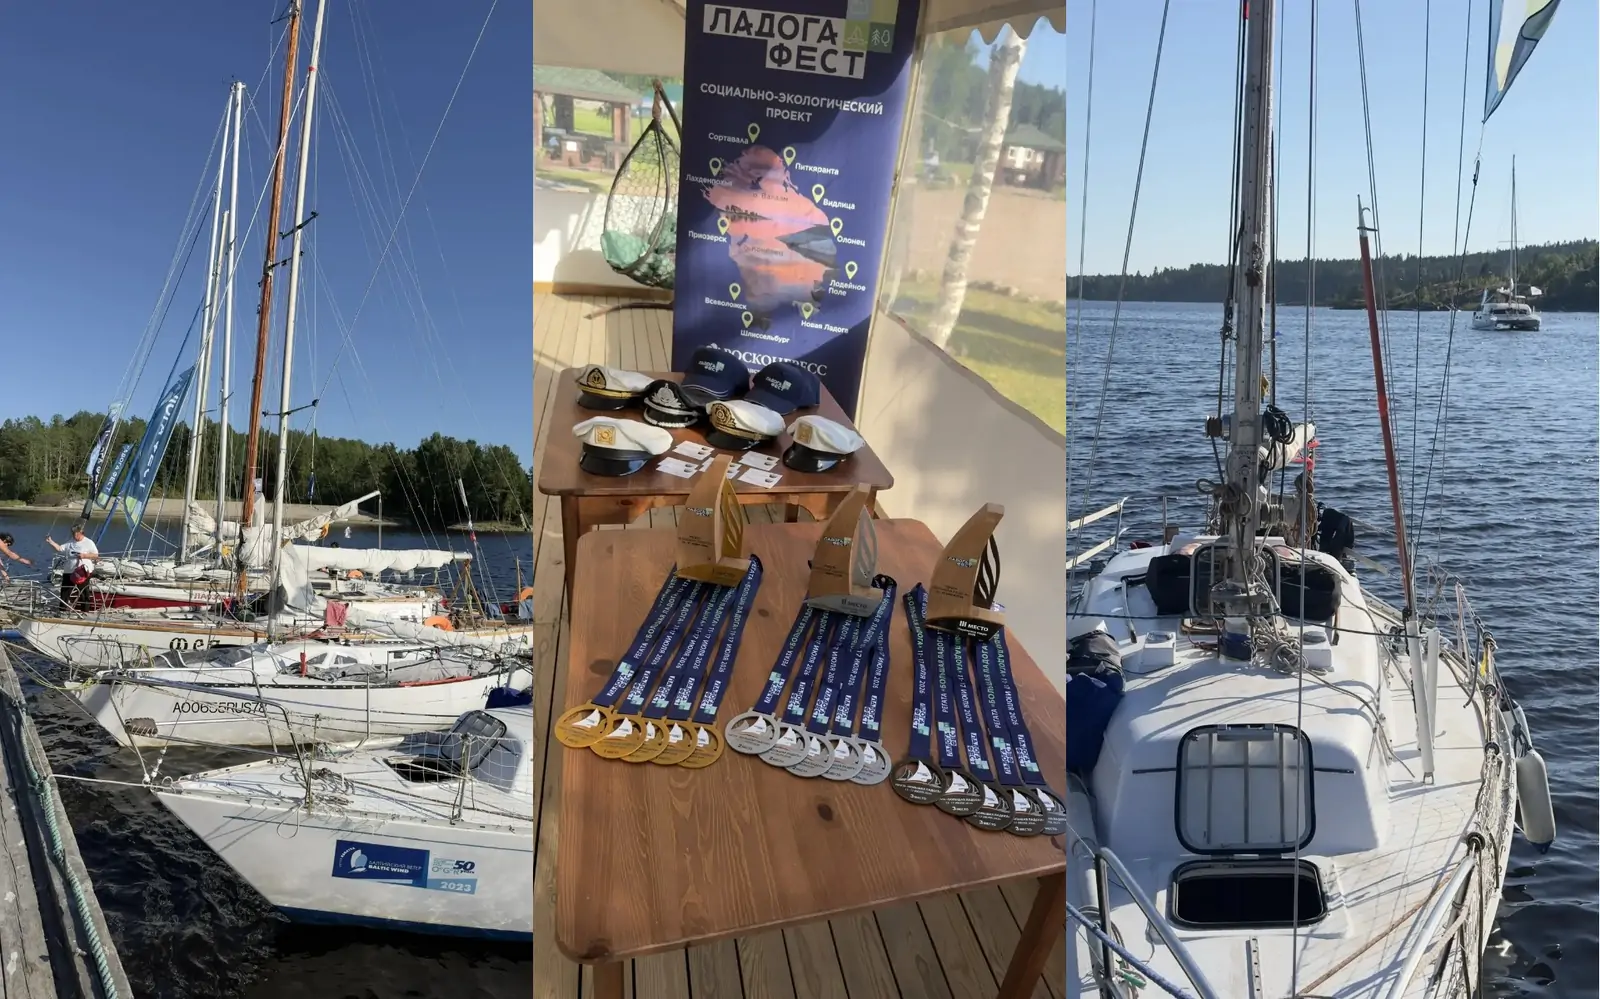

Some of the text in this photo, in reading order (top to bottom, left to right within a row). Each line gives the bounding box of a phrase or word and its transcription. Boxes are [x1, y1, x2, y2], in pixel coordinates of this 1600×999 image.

[709, 7, 839, 46] ЛАДОГА
[769, 42, 864, 76] ФЕСТ
[700, 82, 884, 116] СОЦИАЛЬНО-ЭКОЛОГИЧЕСКИЙ
[766, 107, 812, 123] ПРОЕКТ
[708, 132, 749, 145] Сортавала
[795, 162, 839, 176] Питкяранта
[823, 198, 856, 211] Видлица
[688, 230, 728, 244] Приозерск
[836, 235, 866, 248] Олонец
[828, 287, 848, 297] Поле
[829, 279, 867, 292] Лодейное
[704, 297, 748, 311] Всеволожск
[801, 320, 849, 334] Новая Ладога
[740, 329, 791, 344] Шлиссельбург
[967, 623, 989, 632] МЕСТО
[781, 649, 793, 667] РЕГАТА
[809, 644, 820, 664] ИЮЛЯ
[830, 650, 839, 672] ИЮЛЯ
[876, 657, 884, 676] ИЮЛЯ
[940, 693, 948, 713] РЕГАТА
[960, 689, 970, 708] ИЮЛЯ
[1004, 690, 1014, 711] ИЮЛЯ
[964, 708, 973, 723] 2026
[991, 708, 1001, 729] РЕГАТА
[453, 860, 476, 871] 50
[440, 881, 472, 892] 2023
